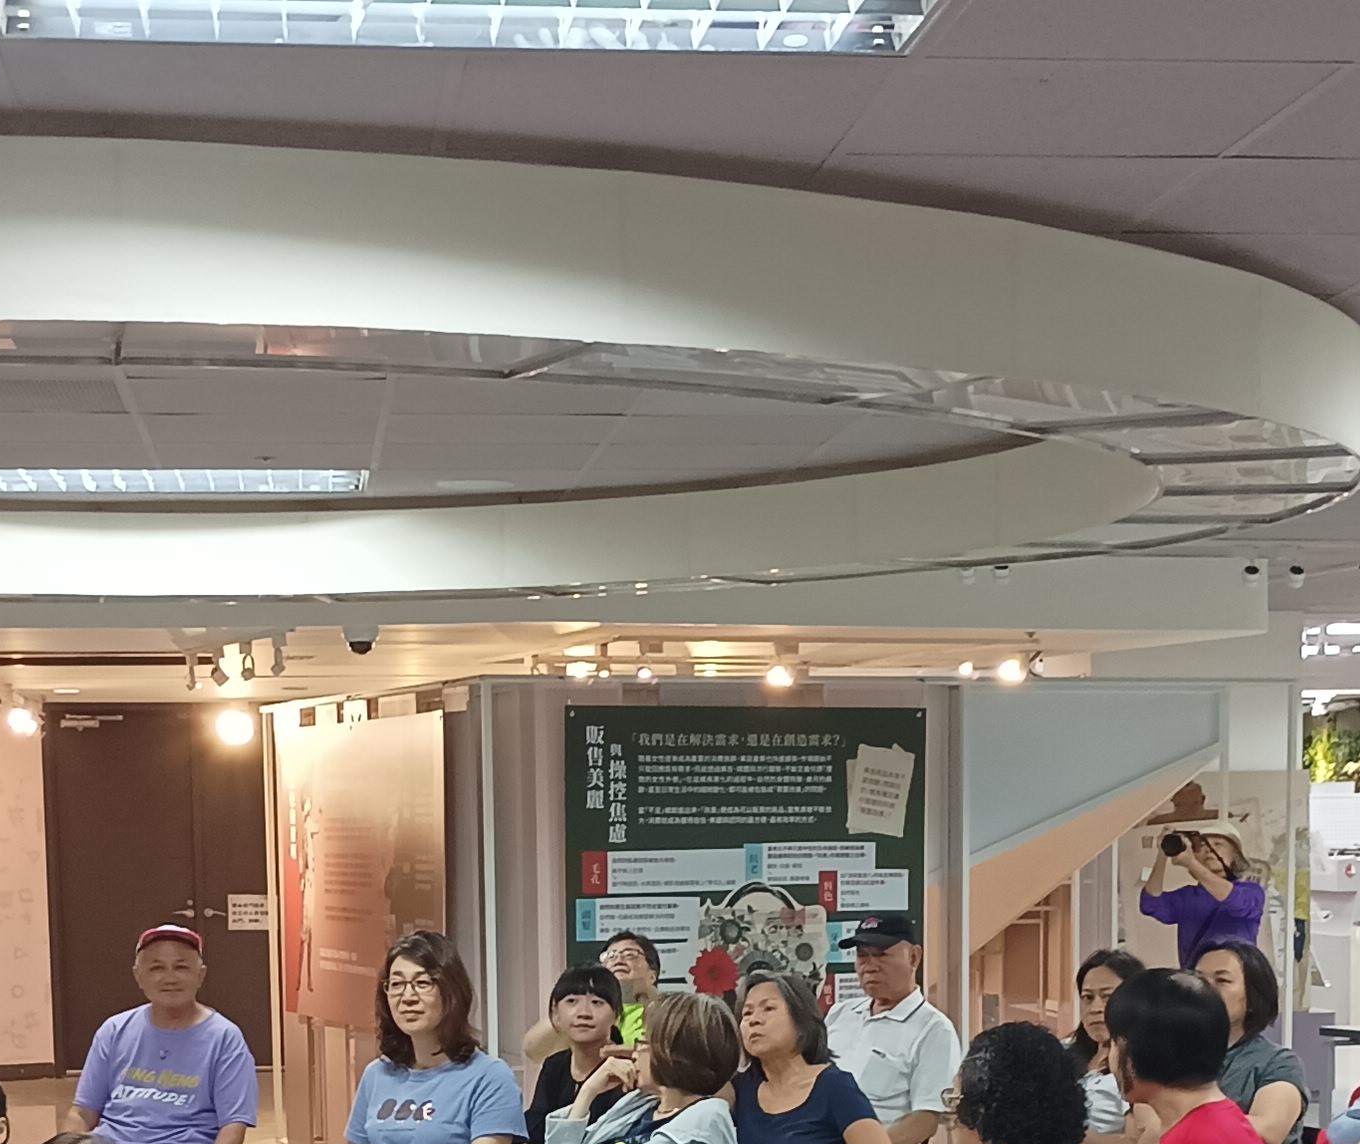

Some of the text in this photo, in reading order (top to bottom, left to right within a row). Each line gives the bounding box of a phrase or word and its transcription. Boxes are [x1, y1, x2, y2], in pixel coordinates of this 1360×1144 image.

[585, 725, 605, 809] 販售美麗
[111, 1085, 196, 1107] ATTITUDE!
